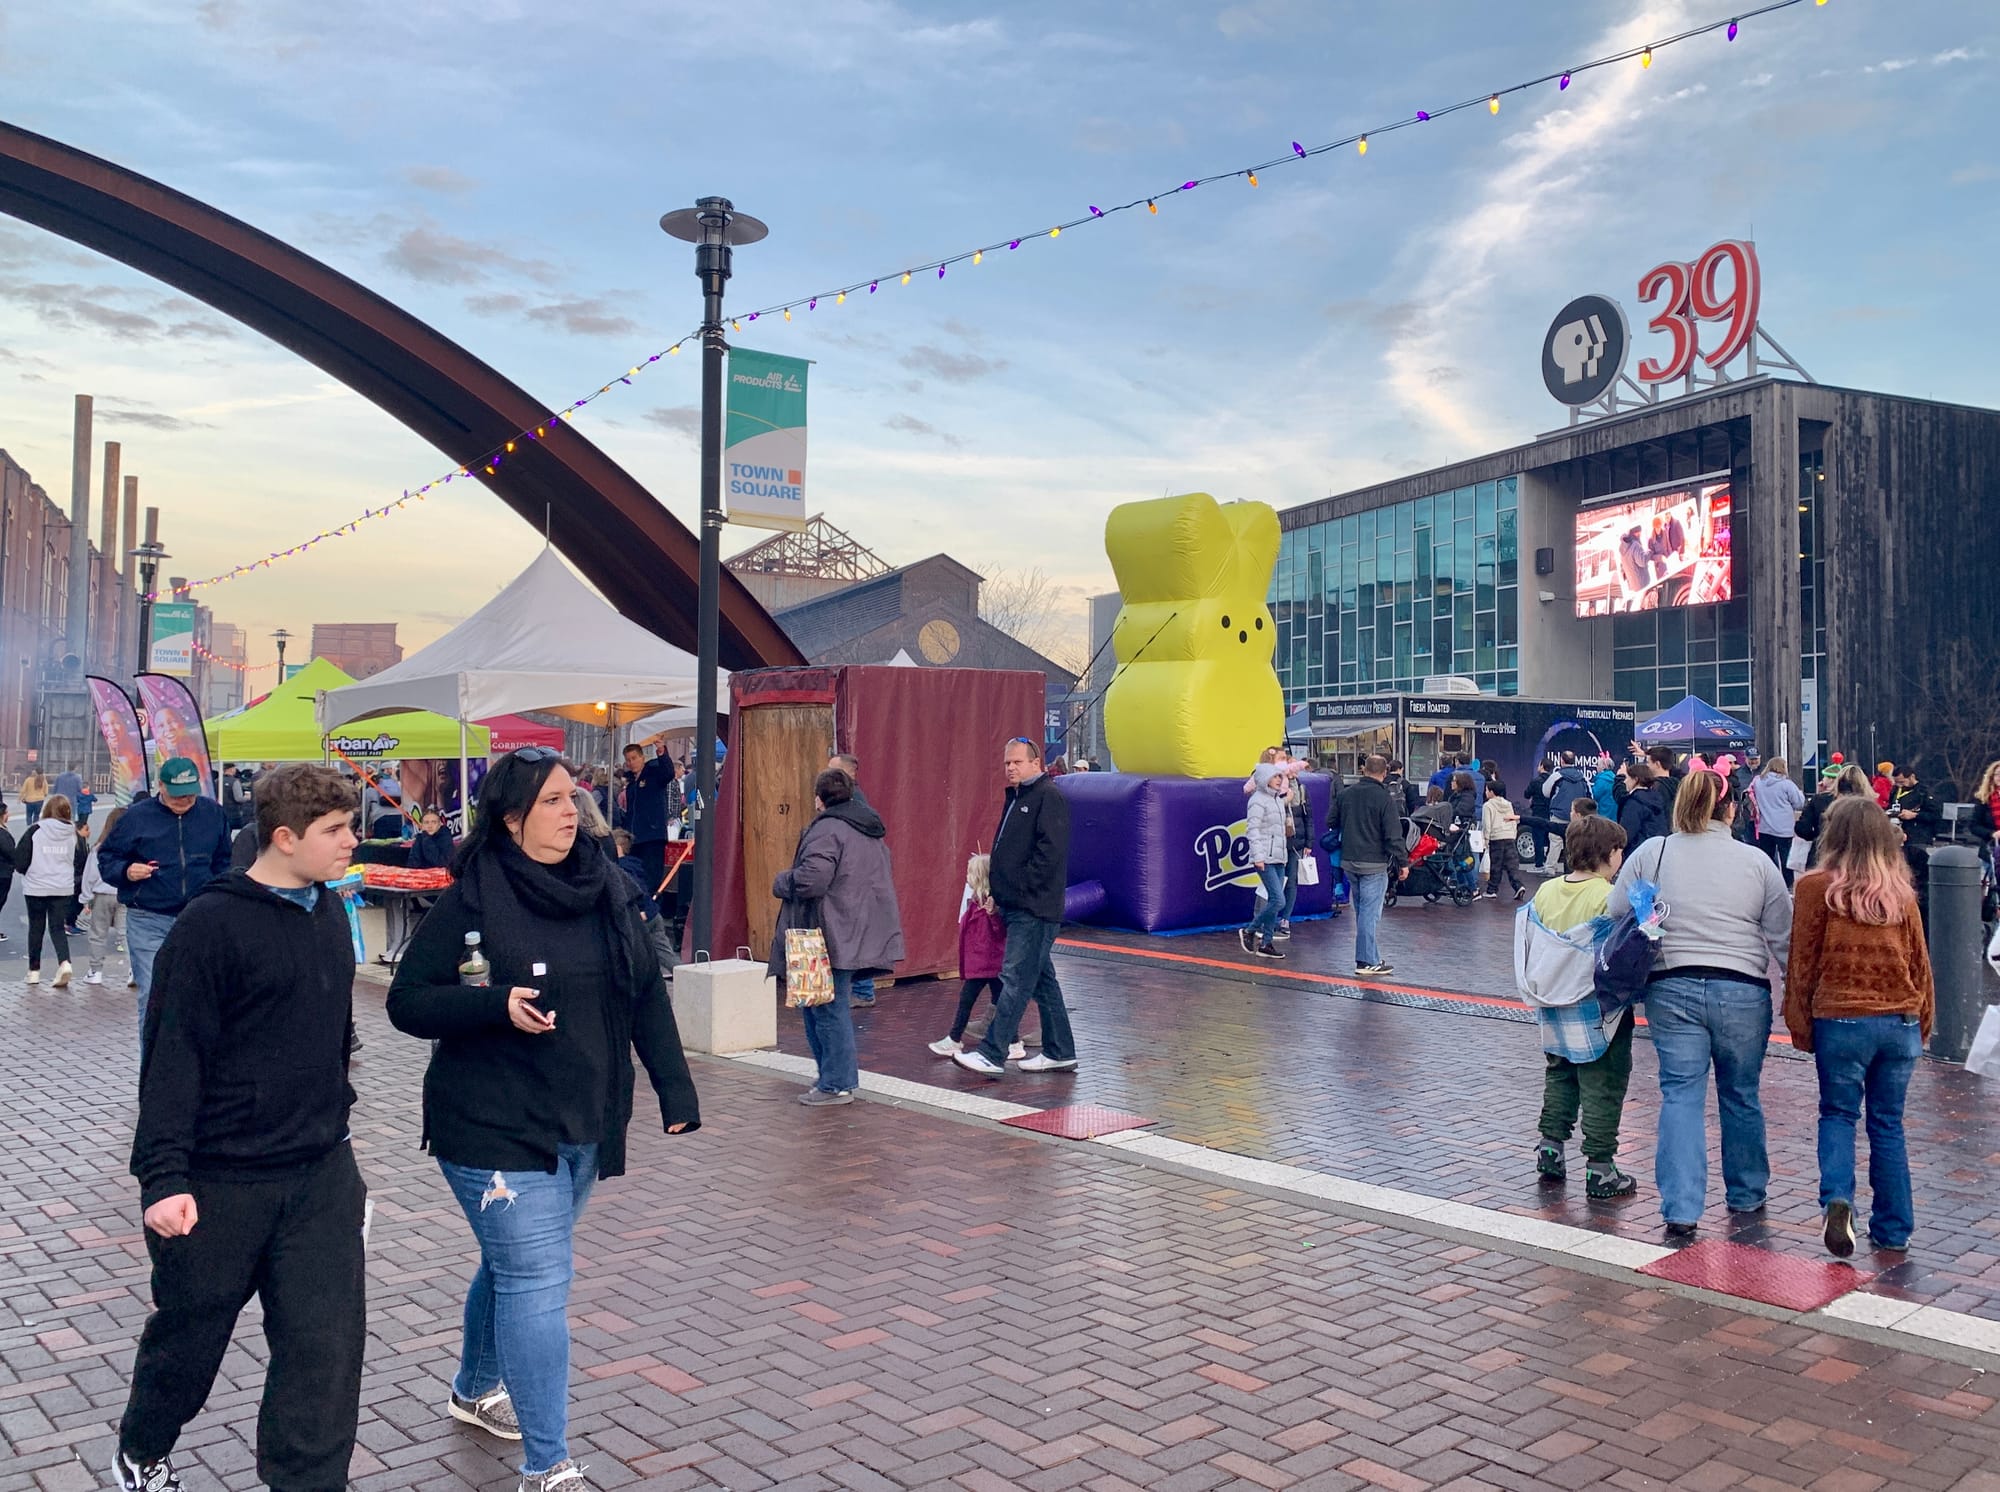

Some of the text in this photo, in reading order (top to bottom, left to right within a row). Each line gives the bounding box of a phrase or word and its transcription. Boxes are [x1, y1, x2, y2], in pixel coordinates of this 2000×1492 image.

[1638, 239, 1761, 384] 39
[733, 374, 783, 390] PRODUCTS
[767, 372, 783, 382] AIR
[730, 463, 784, 483] TOWN
[730, 479, 802, 501] SQUARE
[1409, 700, 1450, 714] FRESH ROASTED
[779, 803, 790, 815] 37
